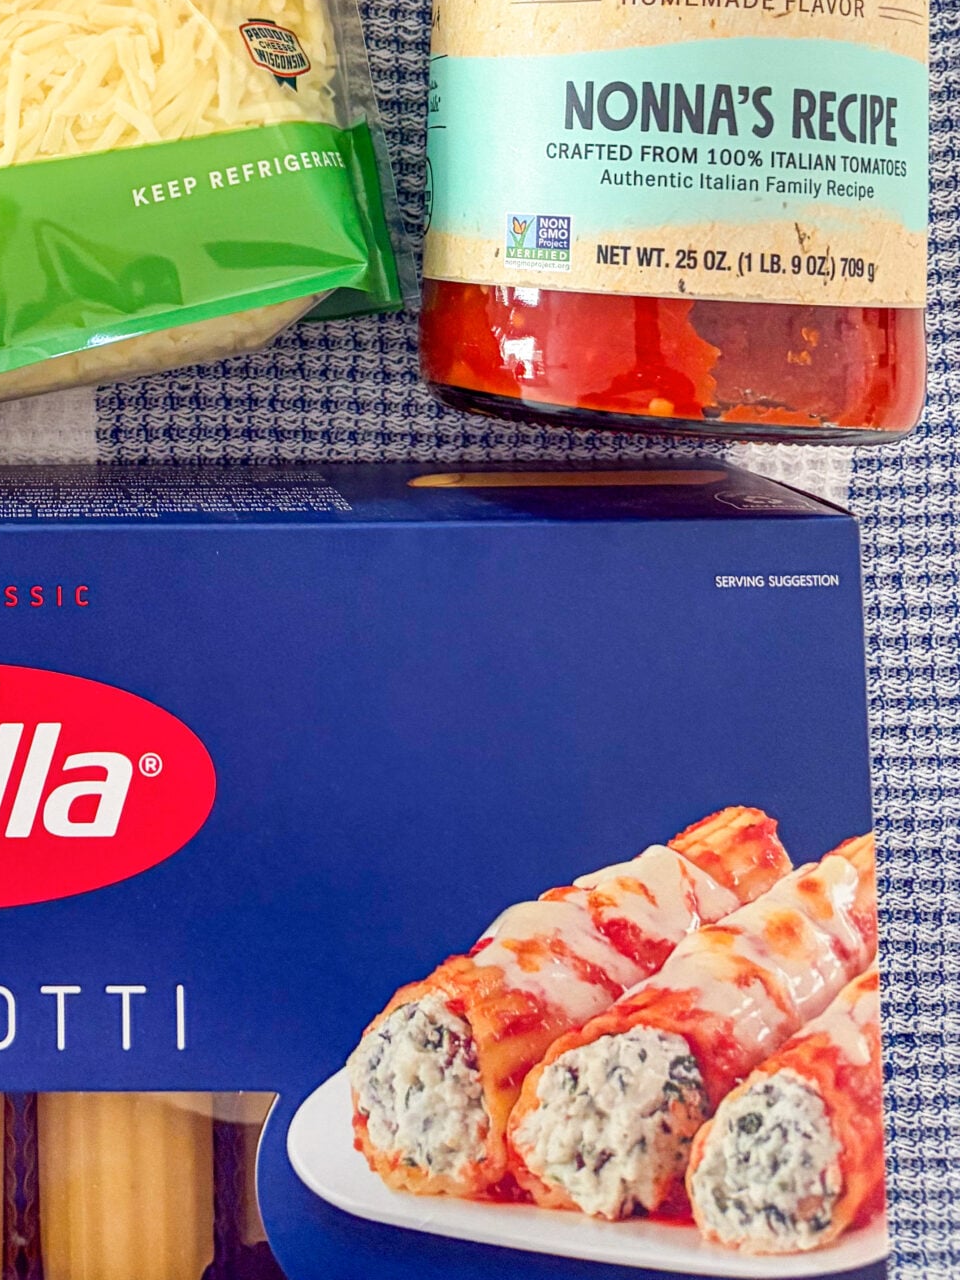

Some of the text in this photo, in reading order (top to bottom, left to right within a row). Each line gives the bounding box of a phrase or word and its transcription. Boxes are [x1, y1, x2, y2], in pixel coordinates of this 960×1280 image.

[244, 27, 294, 45] PROUDLY
[254, 48, 307, 69] WISCONSIN
[564, 80, 899, 147] NONNA'S RECIPE
[545, 142, 907, 178] CRAFTED FROM 100% ITALIAN TOMATOES
[132, 151, 345, 207] KEEP REFRIGERATE
[599, 169, 875, 200] Authentic Italian Family Recipe
[540, 218, 568, 229] NON
[539, 228, 568, 239] GMO
[539, 238, 568, 248] Project
[509, 248, 567, 260] VERIFIED
[596, 244, 864, 281] NET WT. 25 OZ. (1 LB. 9 OZ.) 709
[715, 574, 839, 588] SERVING SUGGESTION
